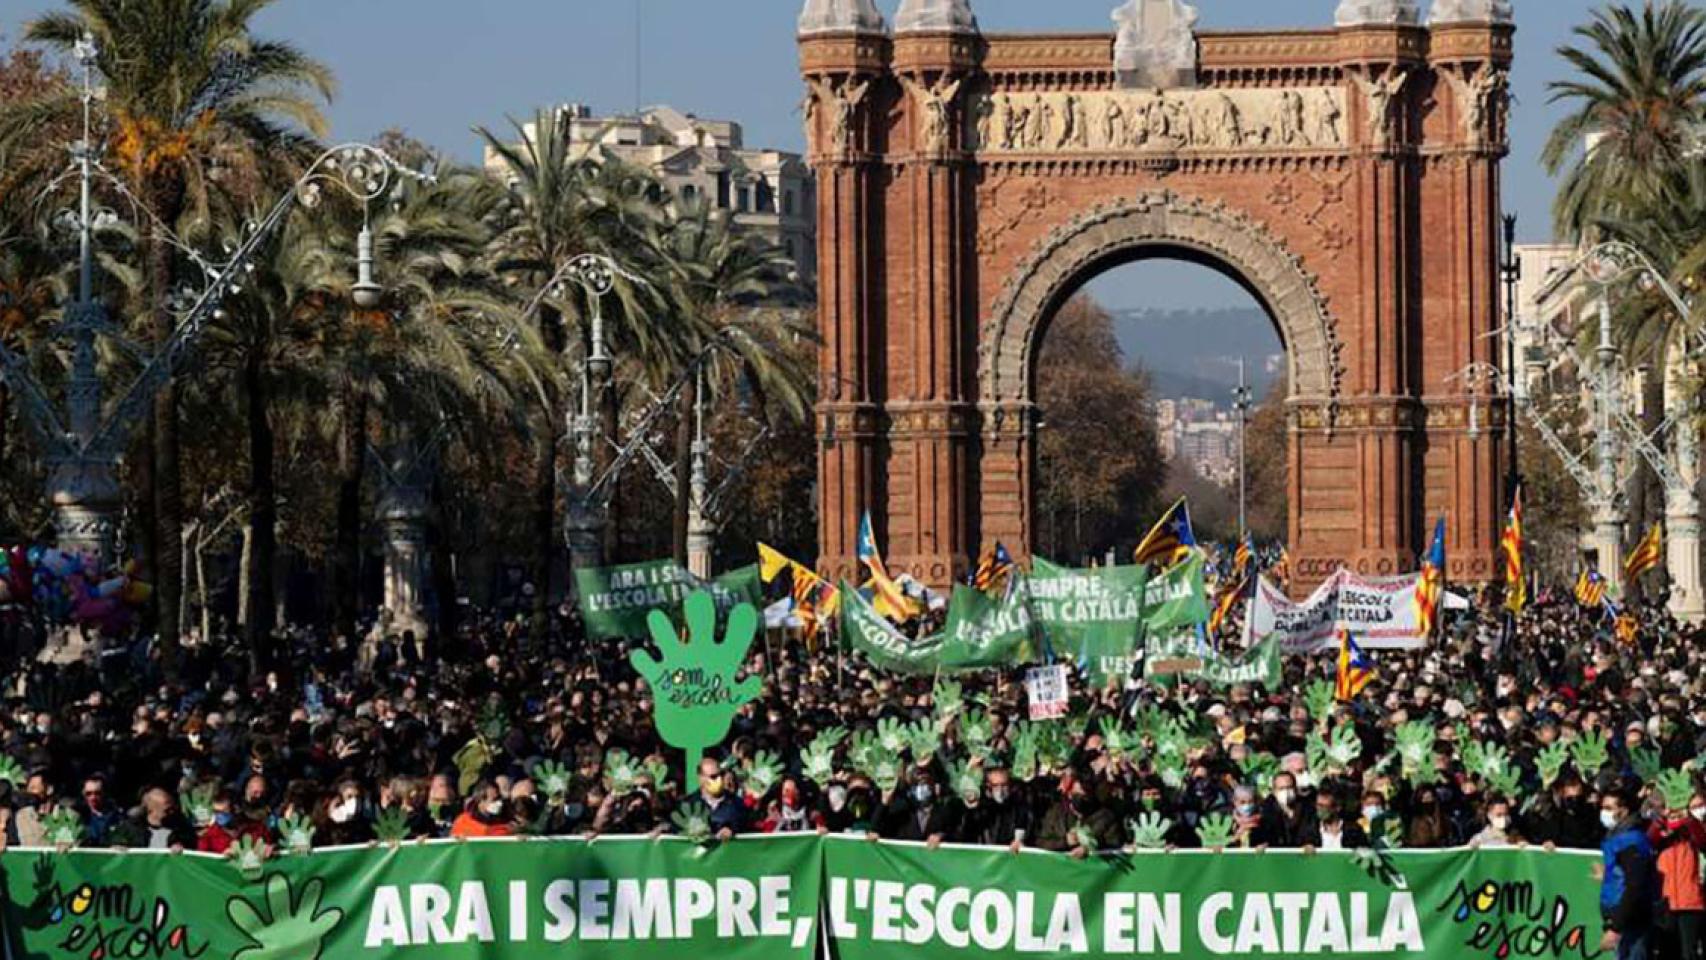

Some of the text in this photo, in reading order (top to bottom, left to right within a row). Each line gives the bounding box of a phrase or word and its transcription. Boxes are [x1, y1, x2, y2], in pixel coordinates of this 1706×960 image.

[588, 585, 667, 612] L'ESCOLA
[610, 567, 646, 590] ARA
[1060, 593, 1138, 622] CATALÀ
[655, 667, 714, 691] som
[46, 880, 147, 925] som
[363, 873, 1425, 954] ARA I SEMPRE, L'ESCOLA EN CATALÀ
[1435, 877, 1549, 923] som
[57, 896, 211, 960] escola
[1463, 901, 1604, 960] escola
